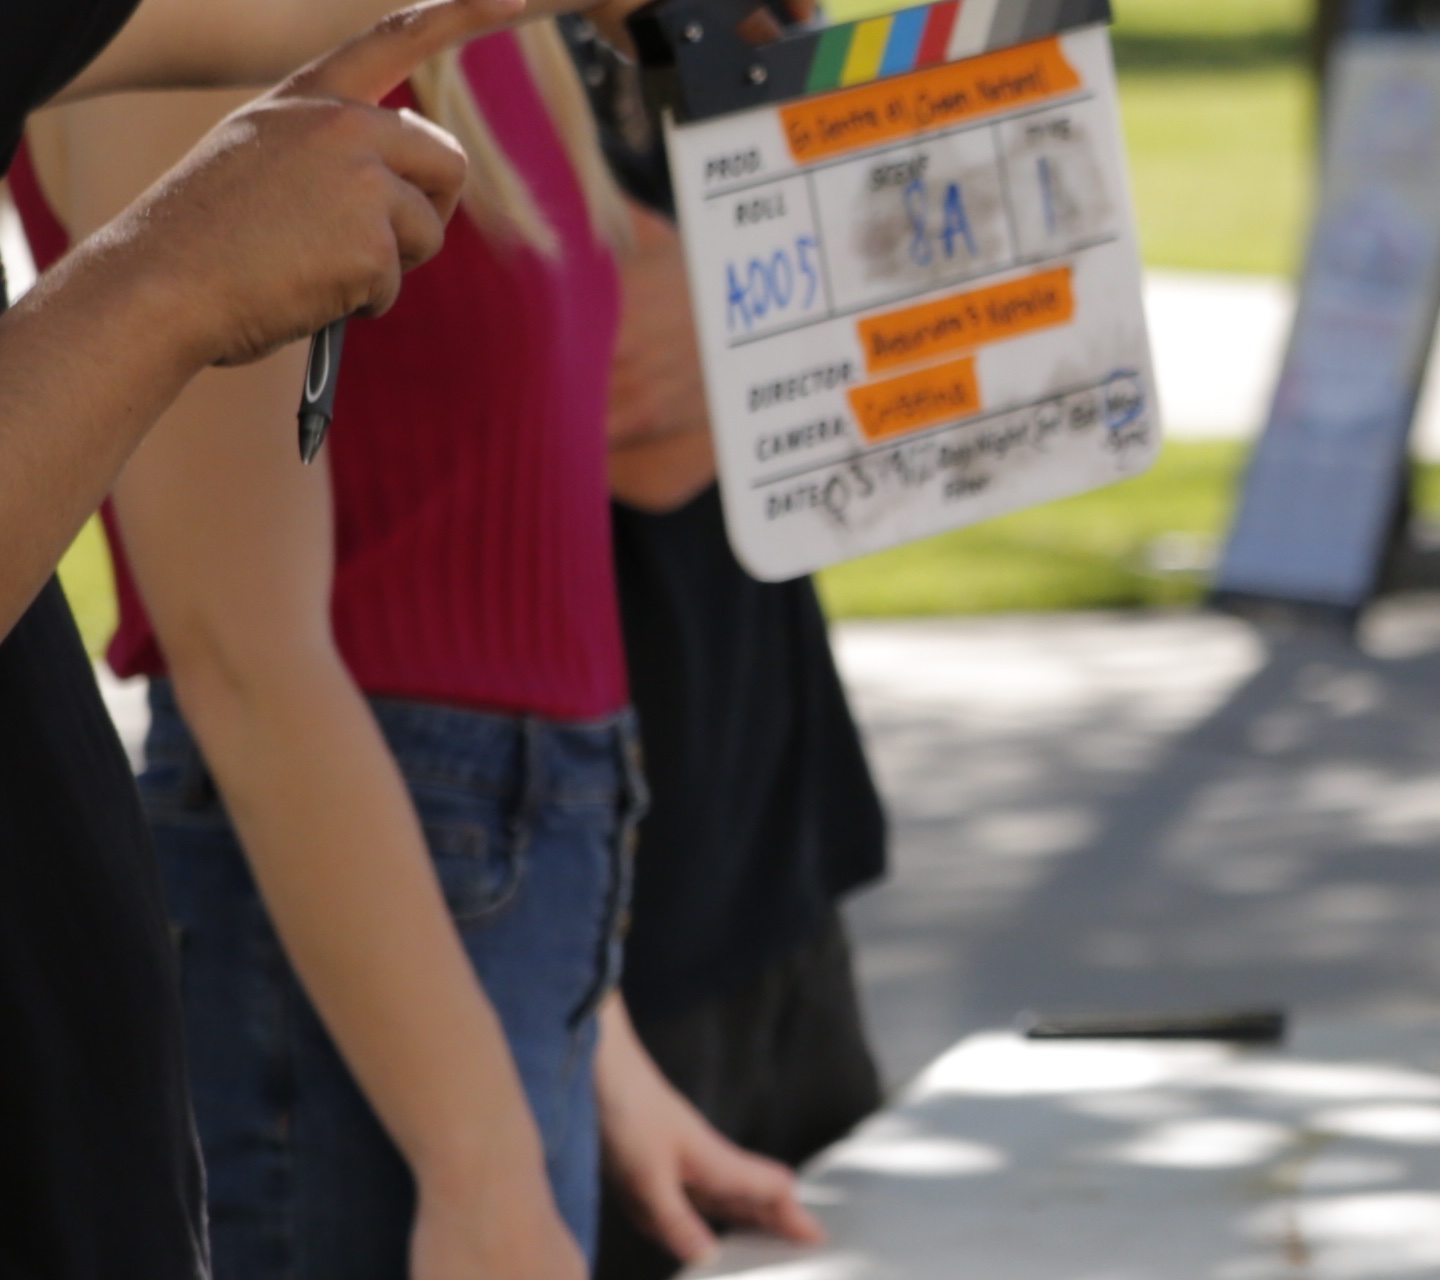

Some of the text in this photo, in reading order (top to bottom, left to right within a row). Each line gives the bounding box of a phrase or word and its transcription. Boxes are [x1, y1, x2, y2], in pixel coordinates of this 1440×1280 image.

[734, 192, 787, 224] ROLL
[902, 177, 979, 267] 8A
[724, 235, 819, 331] A005
